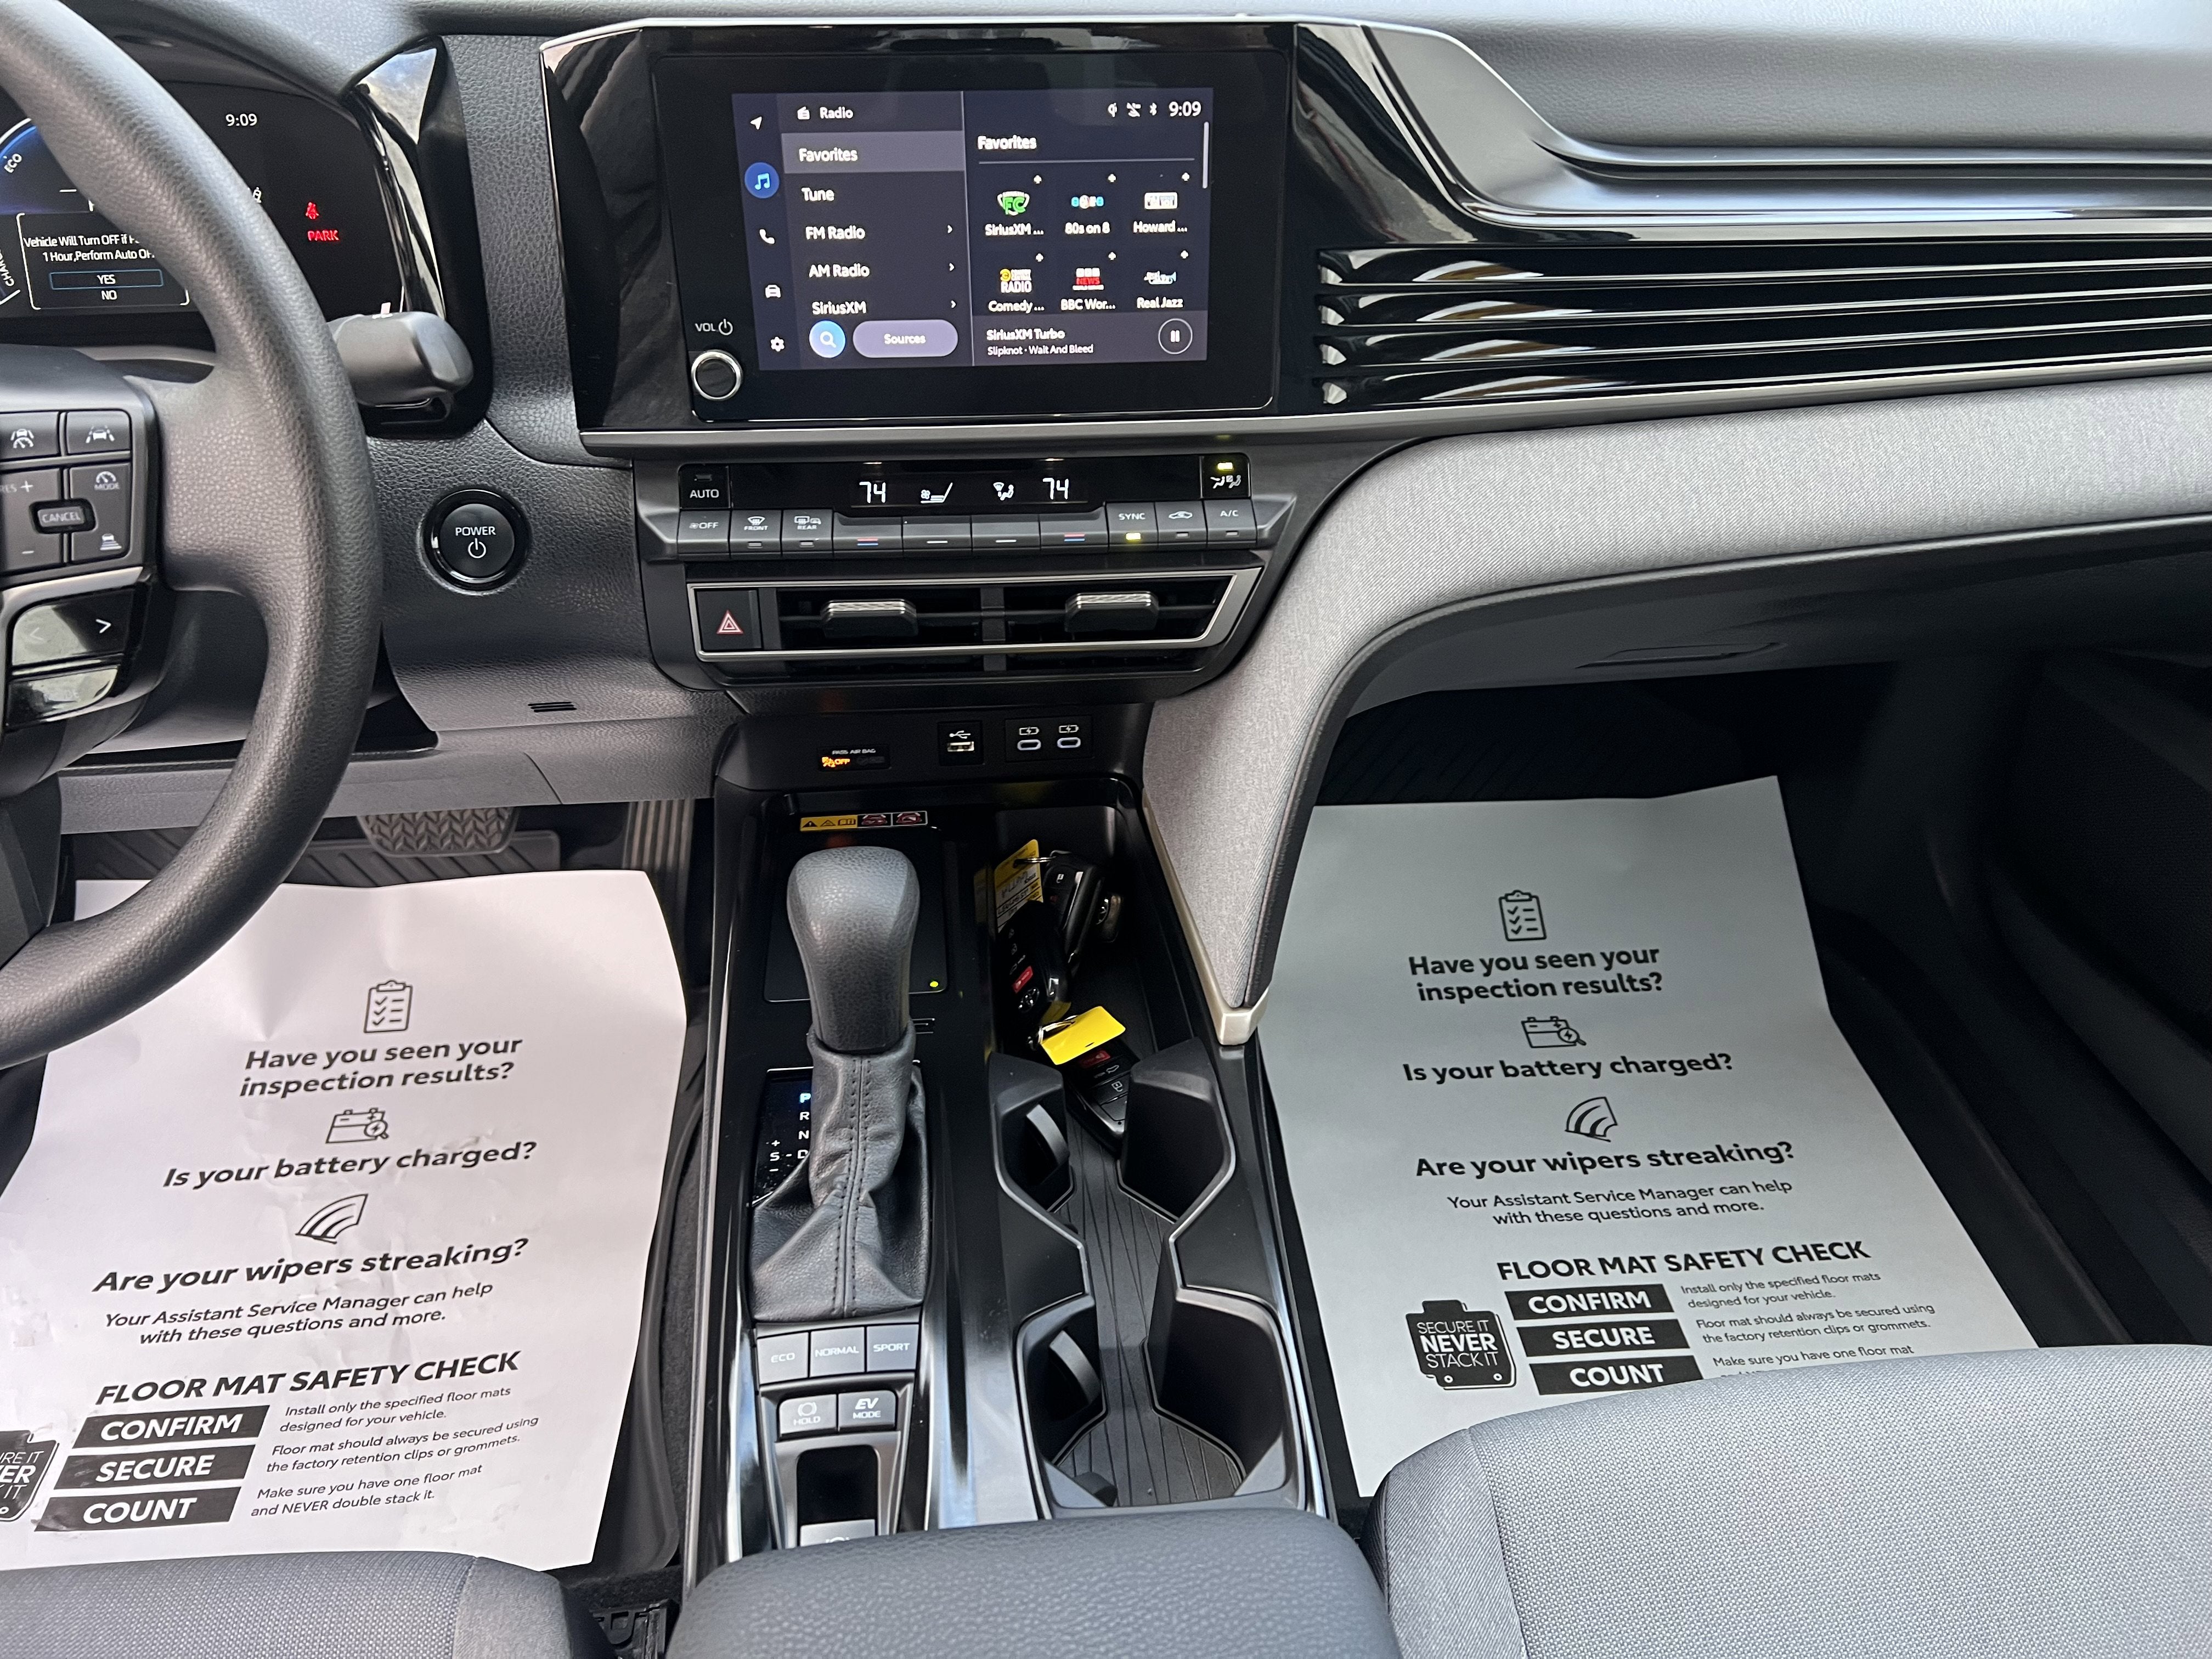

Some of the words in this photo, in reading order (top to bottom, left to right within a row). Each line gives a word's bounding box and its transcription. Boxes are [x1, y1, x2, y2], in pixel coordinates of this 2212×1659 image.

[820, 106, 853, 119] Radio
[1169, 101, 1201, 117] 9:09
[225, 112, 258, 128] 9:09
[978, 135, 1037, 150] Favorites
[799, 147, 858, 162] Favorites
[3, 153, 22, 173] ECO
[802, 188, 834, 201] Tune
[307, 229, 340, 241] PARK
[805, 226, 825, 240] FM
[827, 225, 866, 239] Radio
[1087, 224, 1101, 233] on
[1102, 222, 1110, 233] 8
[24, 236, 58, 247] Vehicle
[59, 235, 76, 246] Will
[77, 235, 100, 245] Turn
[101, 234, 120, 245] OFF
[121, 233, 128, 244] if
[42, 252, 49, 262] 1
[115, 249, 137, 260] Auto
[809, 264, 830, 278] AM
[833, 263, 870, 277] Radio
[97, 274, 116, 285] YES
[101, 290, 117, 300] NO
[1001, 282, 1032, 293] RADIO
[812, 301, 866, 315] SiriusXM
[1061, 299, 1083, 311] BBC
[1137, 298, 1159, 308] Real
[1161, 297, 1183, 308] Jazz
[696, 323, 715, 332] VOL
[986, 329, 1032, 341] SiriusXM
[1034, 328, 1065, 340] Turbo
[884, 333, 926, 345] Sources
[988, 346, 1023, 357] Slipknot
[1029, 345, 1049, 355] Wait
[1050, 345, 1068, 354] And
[1069, 344, 1093, 354] Bleed
[690, 489, 719, 499] AUTO
[859, 481, 887, 504] 74
[1043, 478, 1069, 500] 74
[42, 512, 81, 523] CANCEL
[1119, 512, 1146, 521] SYNC
[455, 526, 496, 536] POWER
[1408, 955, 1475, 976] Have
[1480, 955, 1530, 977] you
[1534, 951, 1596, 970] seen
[1600, 948, 1660, 970] your
[1418, 980, 1558, 1004] inspection
[1562, 972, 1663, 996] results?
[245, 1049, 317, 1070] Have
[325, 1046, 376, 1069] you
[385, 1043, 450, 1062] seen
[457, 1039, 523, 1059] your
[1403, 1063, 1427, 1081] Is
[1431, 1063, 1494, 1085] your
[1499, 1057, 1602, 1079] battery
[1609, 1052, 1734, 1076] charged?
[240, 1073, 394, 1099] inspection
[401, 1062, 515, 1086] results?
[799, 1093, 811, 1103] P
[799, 1111, 810, 1120] R
[798, 1130, 809, 1139] N
[770, 1152, 780, 1161] S
[798, 1150, 809, 1159] D
[1416, 1158, 1466, 1177] Are
[1470, 1158, 1537, 1180] your
[1542, 1152, 1641, 1175] wipers
[1646, 1141, 1795, 1165] streaking?
[163, 1168, 189, 1187] Is
[193, 1164, 269, 1190] your
[274, 1154, 390, 1180] battery
[396, 1141, 538, 1169] charged?
[1447, 1195, 1488, 1209] Your
[1493, 1193, 1572, 1207] Assistant
[1575, 1189, 1636, 1204] Service
[1638, 1186, 1714, 1202] Manager
[1719, 1183, 1751, 1196] can
[1752, 1179, 1793, 1194] help
[1493, 1211, 1532, 1225] with
[1535, 1209, 1584, 1222] these
[1587, 1206, 1672, 1223] questions
[1676, 1203, 1710, 1216] and
[1713, 1200, 1764, 1214] more.
[92, 1270, 155, 1293] Are
[156, 1268, 239, 1295] your
[246, 1253, 353, 1284] wipers
[361, 1238, 529, 1274] streaking?
[1497, 1259, 1596, 1280] FLOOR
[1598, 1255, 1658, 1275] MAT
[1663, 1247, 1764, 1273] SAFETY
[1771, 1240, 1872, 1263] CHECK
[1680, 1284, 1717, 1295] Install
[1719, 1282, 1743, 1295] only
[1745, 1280, 1765, 1290] the
[1768, 1276, 1820, 1291] specified
[1822, 1273, 1850, 1285] floor
[1852, 1271, 1881, 1282] mats
[1527, 1291, 1652, 1314] CONFIRM
[1417, 1321, 1475, 1335] SECURE
[1477, 1320, 1489, 1332] IT
[1420, 1333, 1498, 1353] NEVER
[1552, 1326, 1656, 1351] SECURE
[815, 1346, 859, 1357] NORMAL
[873, 1343, 910, 1352] SPORT
[771, 1352, 795, 1362] ECO
[1426, 1353, 1485, 1369] STACK
[1484, 1352, 1499, 1366] IT
[95, 1376, 207, 1405] FLOOR
[212, 1373, 287, 1397] MAT
[289, 1364, 410, 1392] SAFETY
[414, 1350, 522, 1380] CHECK
[1570, 1363, 1664, 1387] COUNT
[855, 1398, 879, 1409] EV
[793, 1415, 820, 1425] HOLD
[853, 1410, 881, 1419] MODE
[100, 1413, 243, 1441] CONFIRM
[272, 1444, 307, 1457] Floor
[309, 1441, 335, 1453] mat
[337, 1436, 383, 1451] should
[386, 1431, 429, 1447] always
[432, 1430, 449, 1441] be
[452, 1423, 504, 1439] secured
[506, 1416, 539, 1431] using
[95, 1454, 215, 1482] SECURE
[257, 1487, 294, 1499] Make
[297, 1484, 326, 1495] sure
[328, 1482, 353, 1496] you
[358, 1477, 390, 1491] have
[393, 1475, 420, 1487] one
[423, 1471, 455, 1485] floor
[458, 1464, 483, 1479] mat
[251, 1504, 279, 1517] and
[281, 1500, 329, 1515] NEVER
[332, 1495, 381, 1509] double
[385, 1491, 420, 1505] stack
[423, 1489, 436, 1500] it.
[83, 1498, 197, 1524] COUNT
